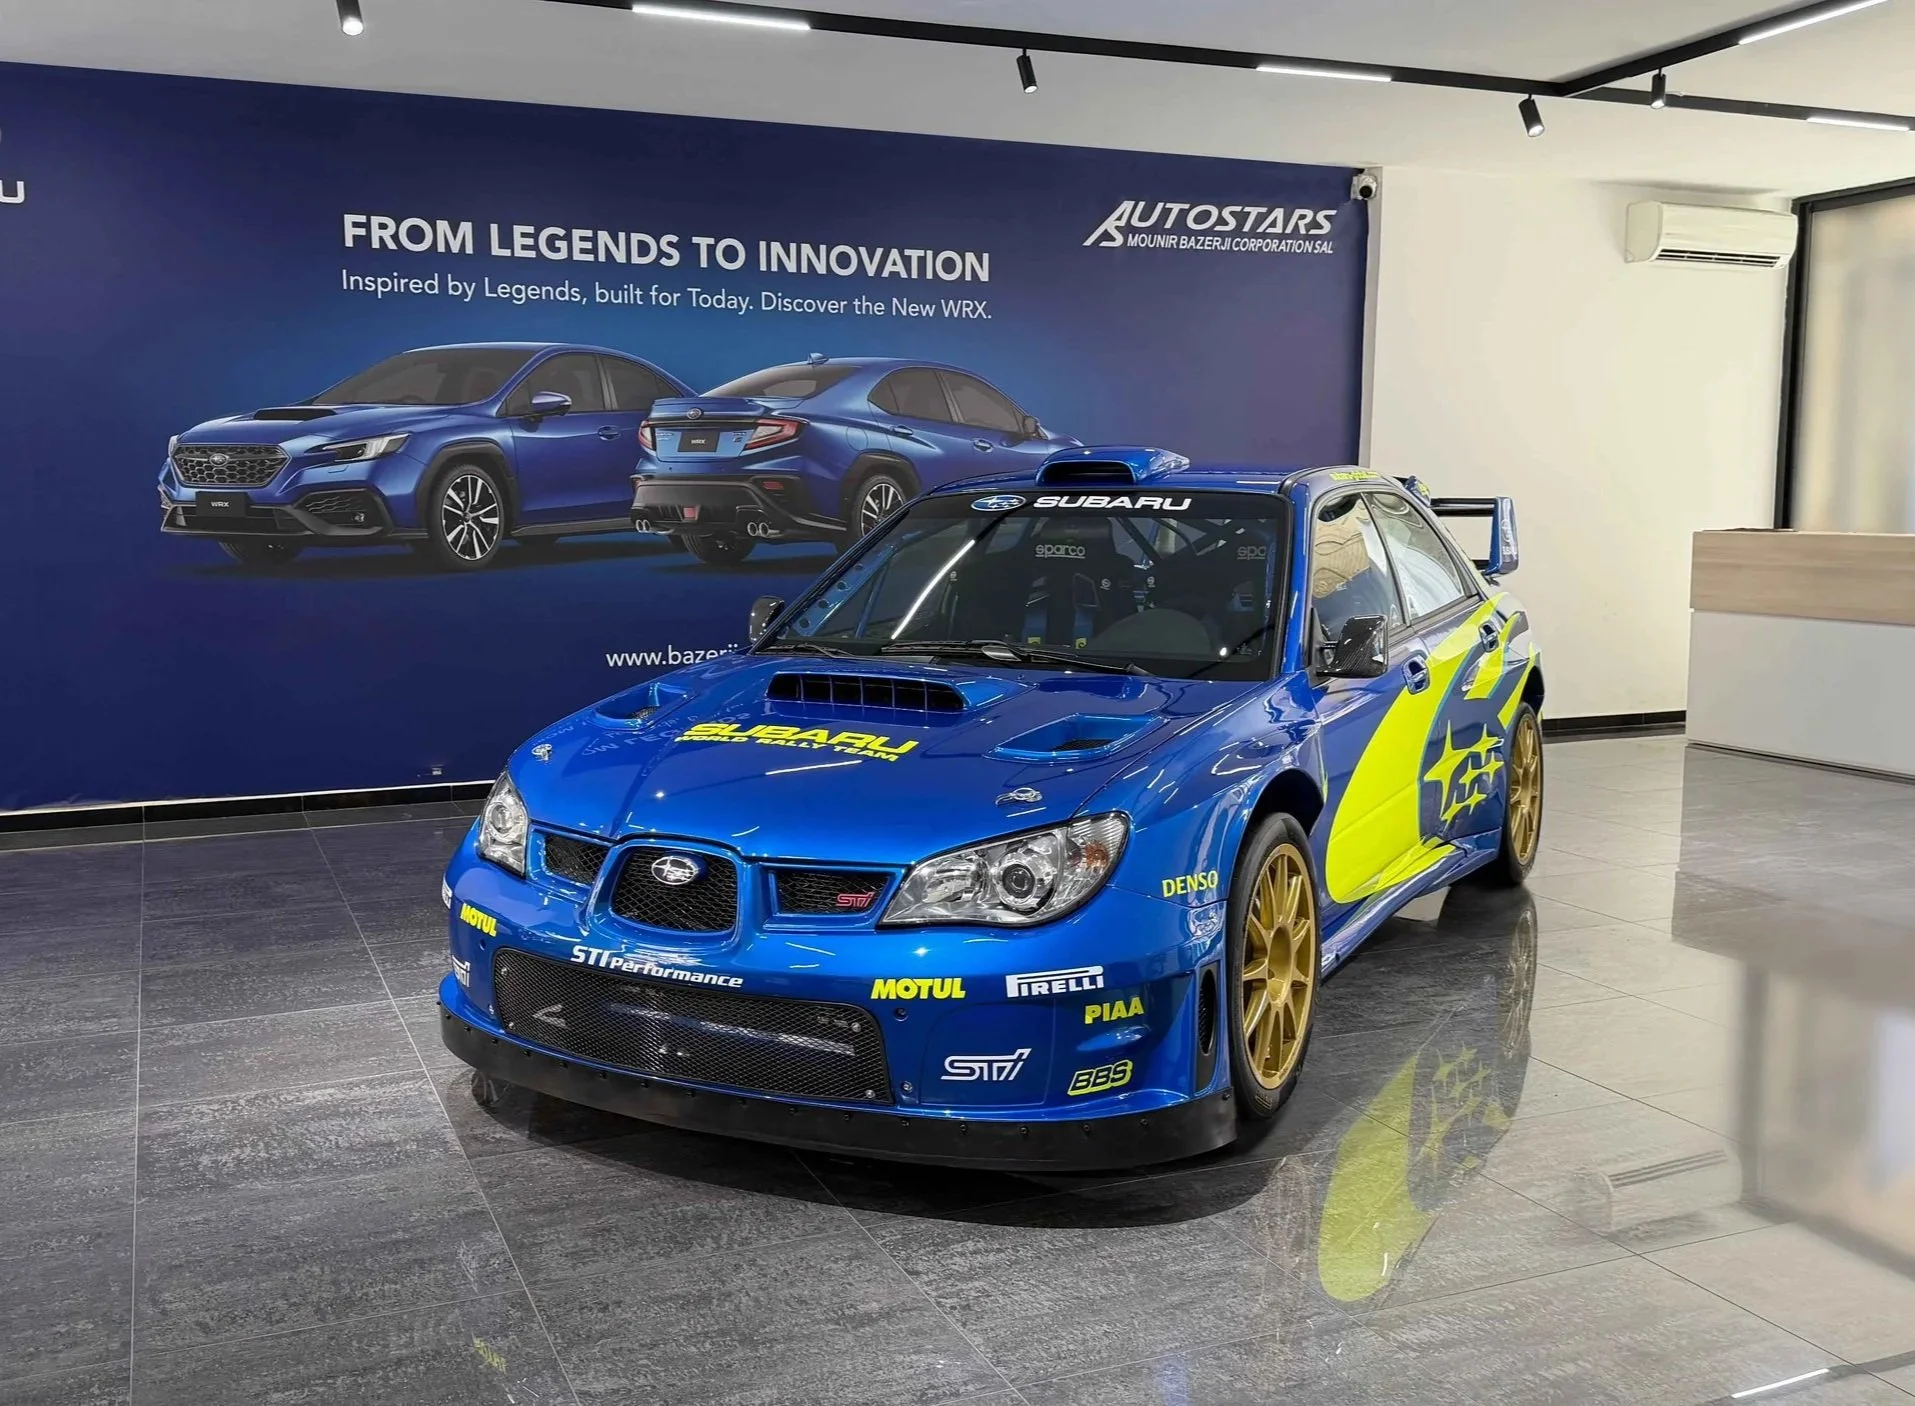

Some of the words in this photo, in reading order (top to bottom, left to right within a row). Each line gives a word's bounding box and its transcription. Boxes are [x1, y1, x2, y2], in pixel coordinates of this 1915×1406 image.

[1083, 200, 1337, 247] AUTOSTARS
[343, 214, 474, 255] FROM
[490, 223, 681, 267] LEGENDS
[692, 236, 746, 270] TO
[759, 240, 990, 282] INNOVATION
[1127, 233, 1178, 249] MOUNIR
[1179, 236, 1231, 251] BAZERJI
[1232, 237, 1313, 253] CORPORATION
[1313, 240, 1333, 254] SAL
[342, 269, 439, 299] Inspired
[448, 273, 475, 301] by
[484, 277, 588, 304] Legends,
[595, 282, 643, 304] built
[650, 285, 681, 306] for
[687, 287, 753, 315] Today.
[761, 291, 848, 314] Discover
[853, 295, 885, 315] the
[892, 297, 936, 317] New
[941, 299, 992, 319] WRX.
[1033, 495, 1193, 511] SUBARU
[1035, 544, 1086, 559] sparco
[606, 643, 739, 667] www.bazer
[683, 723, 920, 754] SUBARU
[755, 738, 828, 749] RALLY
[830, 745, 900, 762] TEAM
[1161, 870, 1219, 898] DENSO
[460, 902, 497, 937] MOTUL
[870, 977, 966, 1000] MOTUL
[1005, 965, 1105, 998] PIRELLI
[1084, 996, 1145, 1025] PIAA
[1067, 1059, 1134, 1097] BBS
